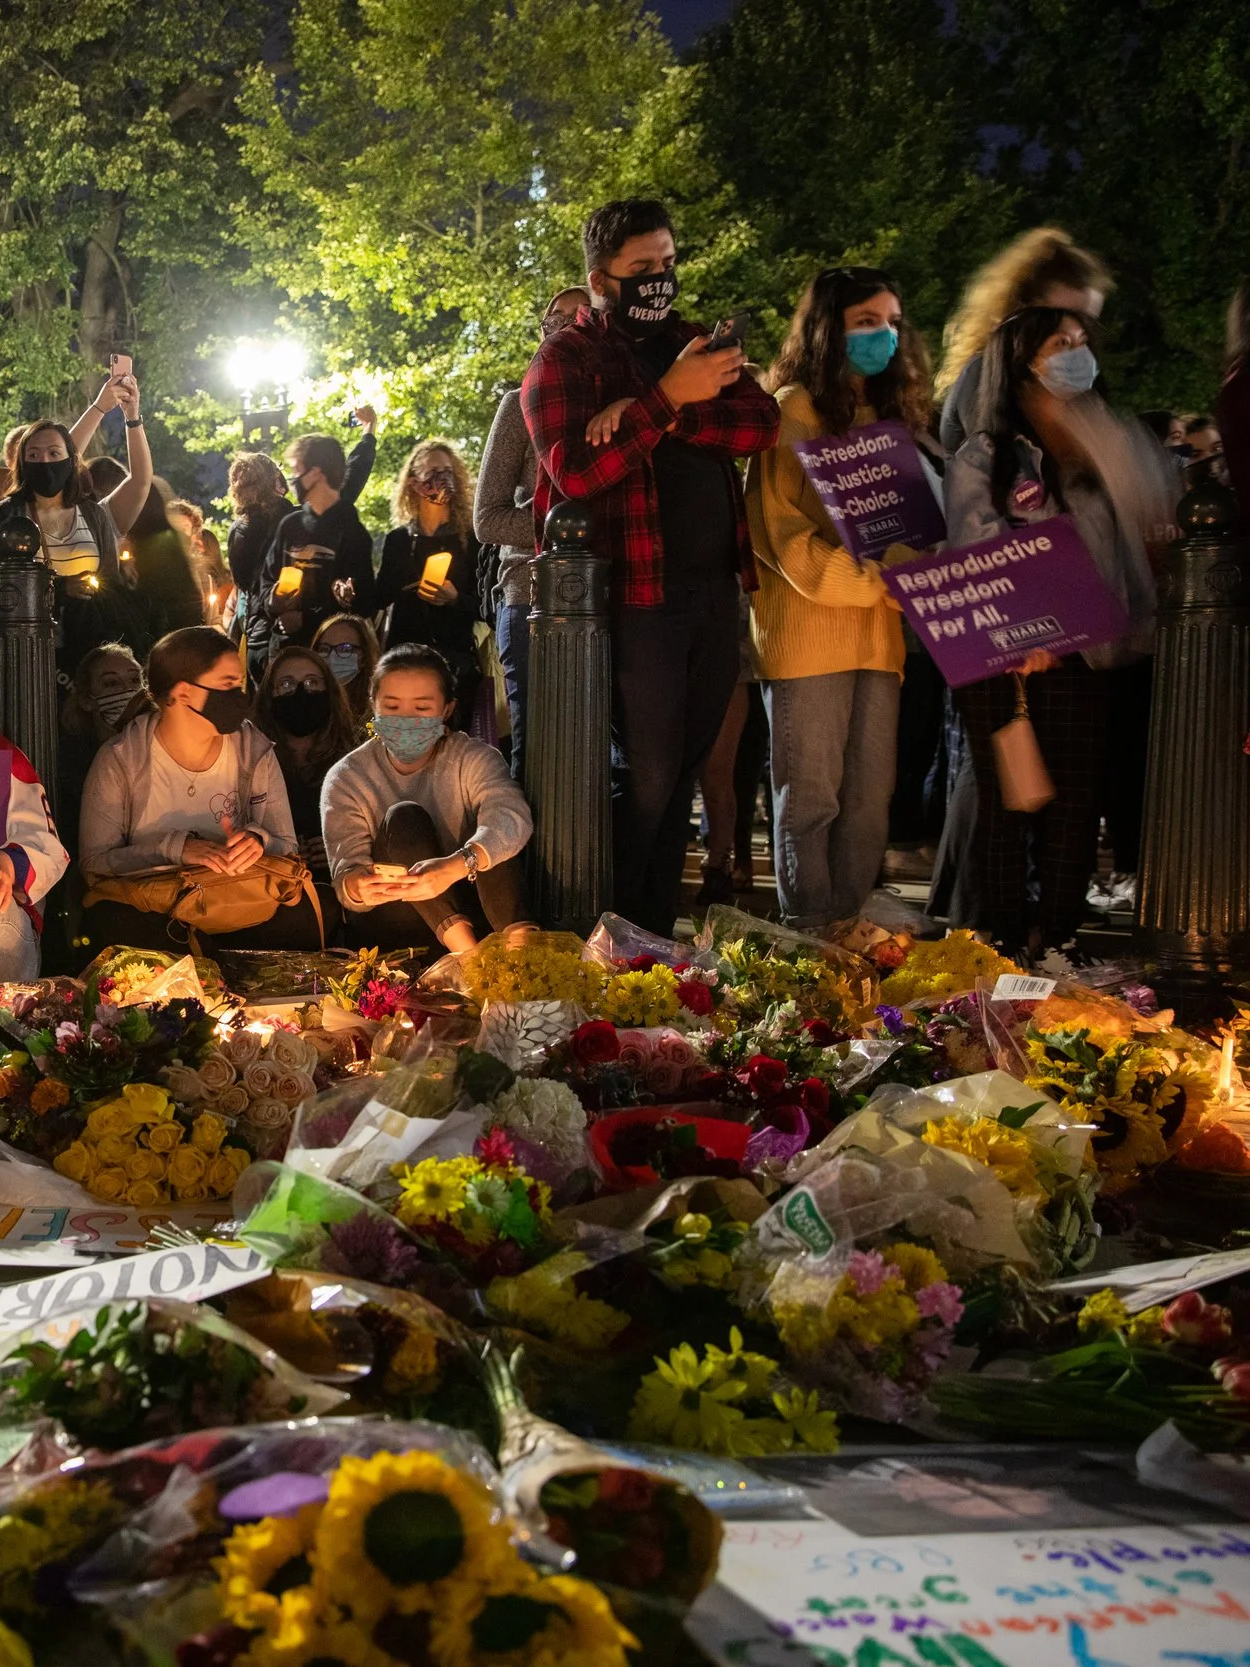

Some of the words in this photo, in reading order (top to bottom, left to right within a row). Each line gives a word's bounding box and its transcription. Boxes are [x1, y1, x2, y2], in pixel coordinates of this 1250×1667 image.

[798, 434, 898, 468] Pro-Freedom.
[812, 463, 898, 494] Pro-Justice.
[824, 490, 905, 520] Pro-Choice.
[869, 518, 899, 533] NARAL
[896, 536, 1052, 593] Reproductive
[910, 577, 1015, 617] Freedom
[926, 616, 966, 641] For
[971, 604, 1010, 630] All.
[1009, 620, 1057, 643] NARAL
